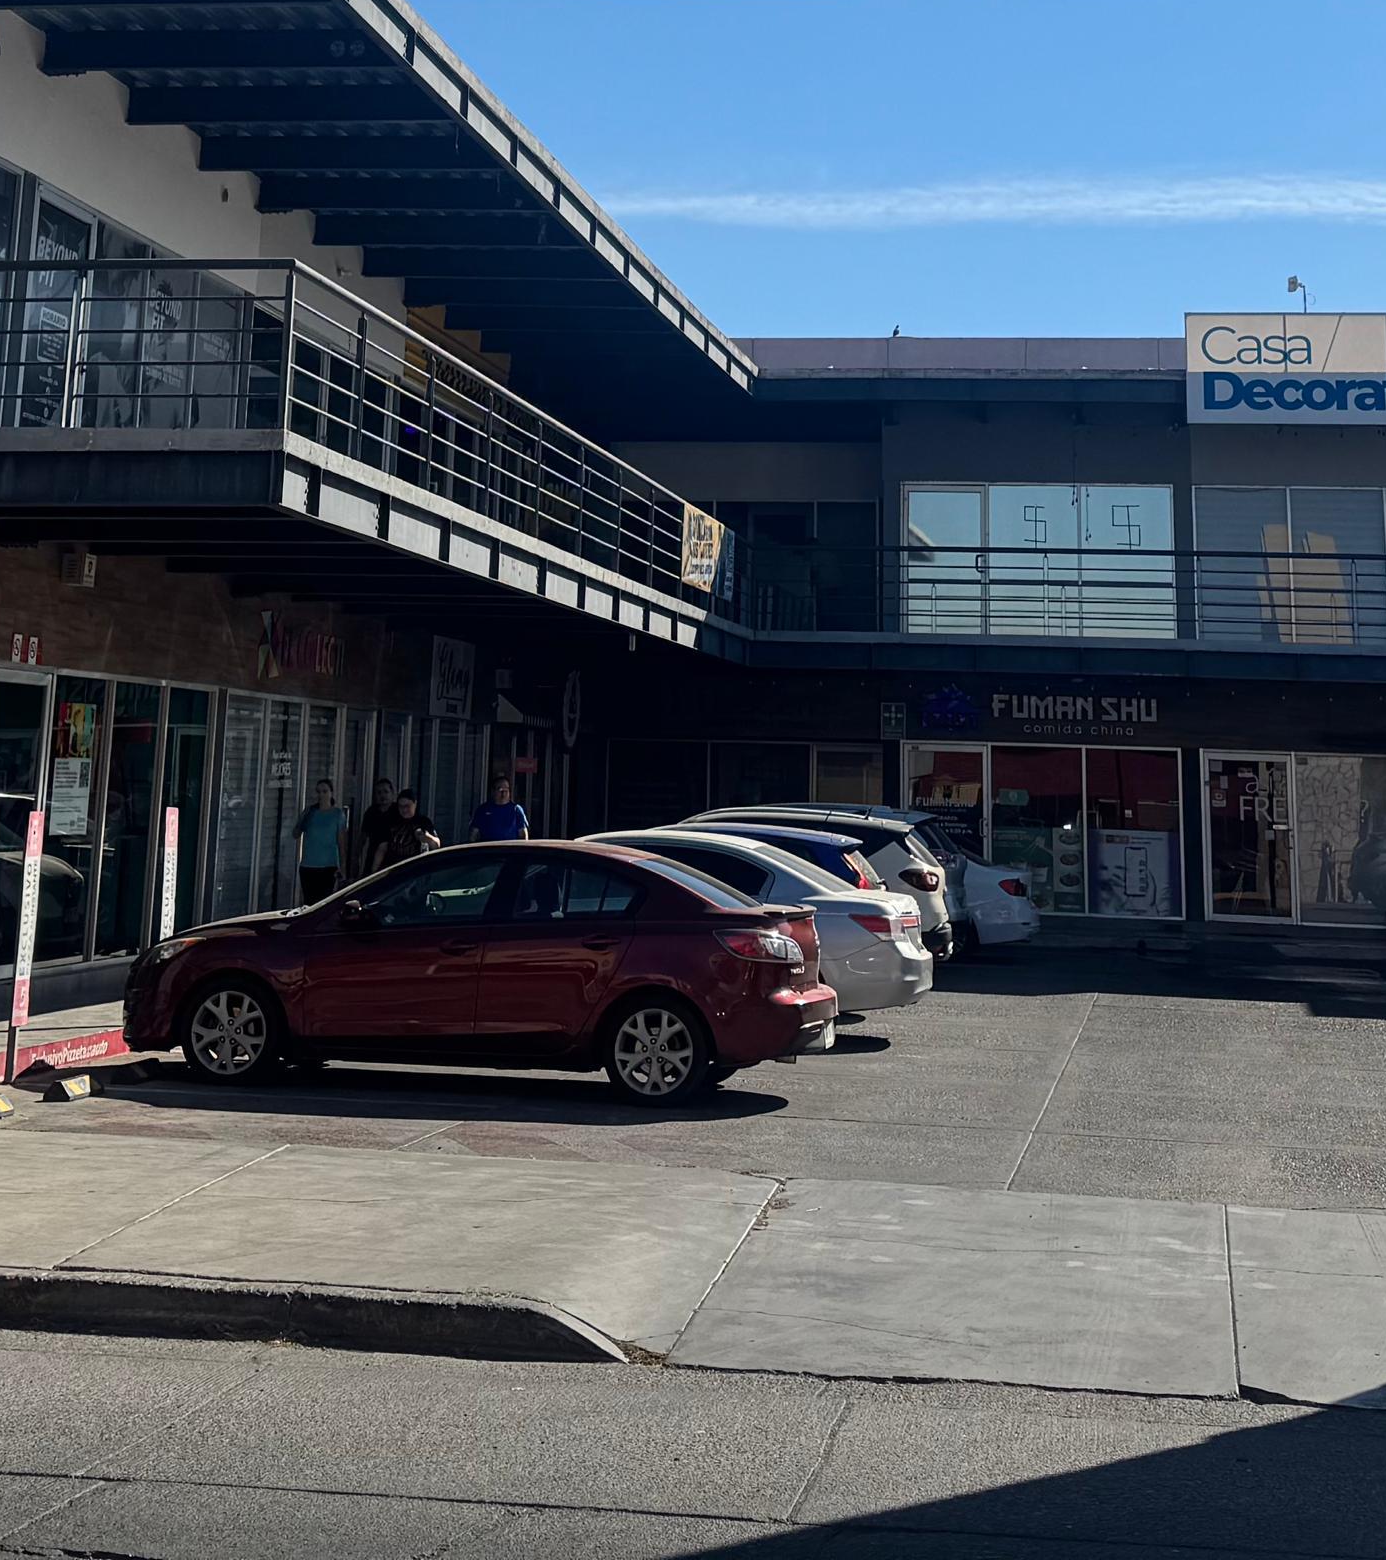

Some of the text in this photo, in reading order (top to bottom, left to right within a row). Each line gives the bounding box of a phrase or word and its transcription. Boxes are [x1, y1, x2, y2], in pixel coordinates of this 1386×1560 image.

[1201, 325, 1313, 366] Casa
[992, 693, 1158, 723] FUMAN SHU
[1023, 721, 1135, 737] comida china
